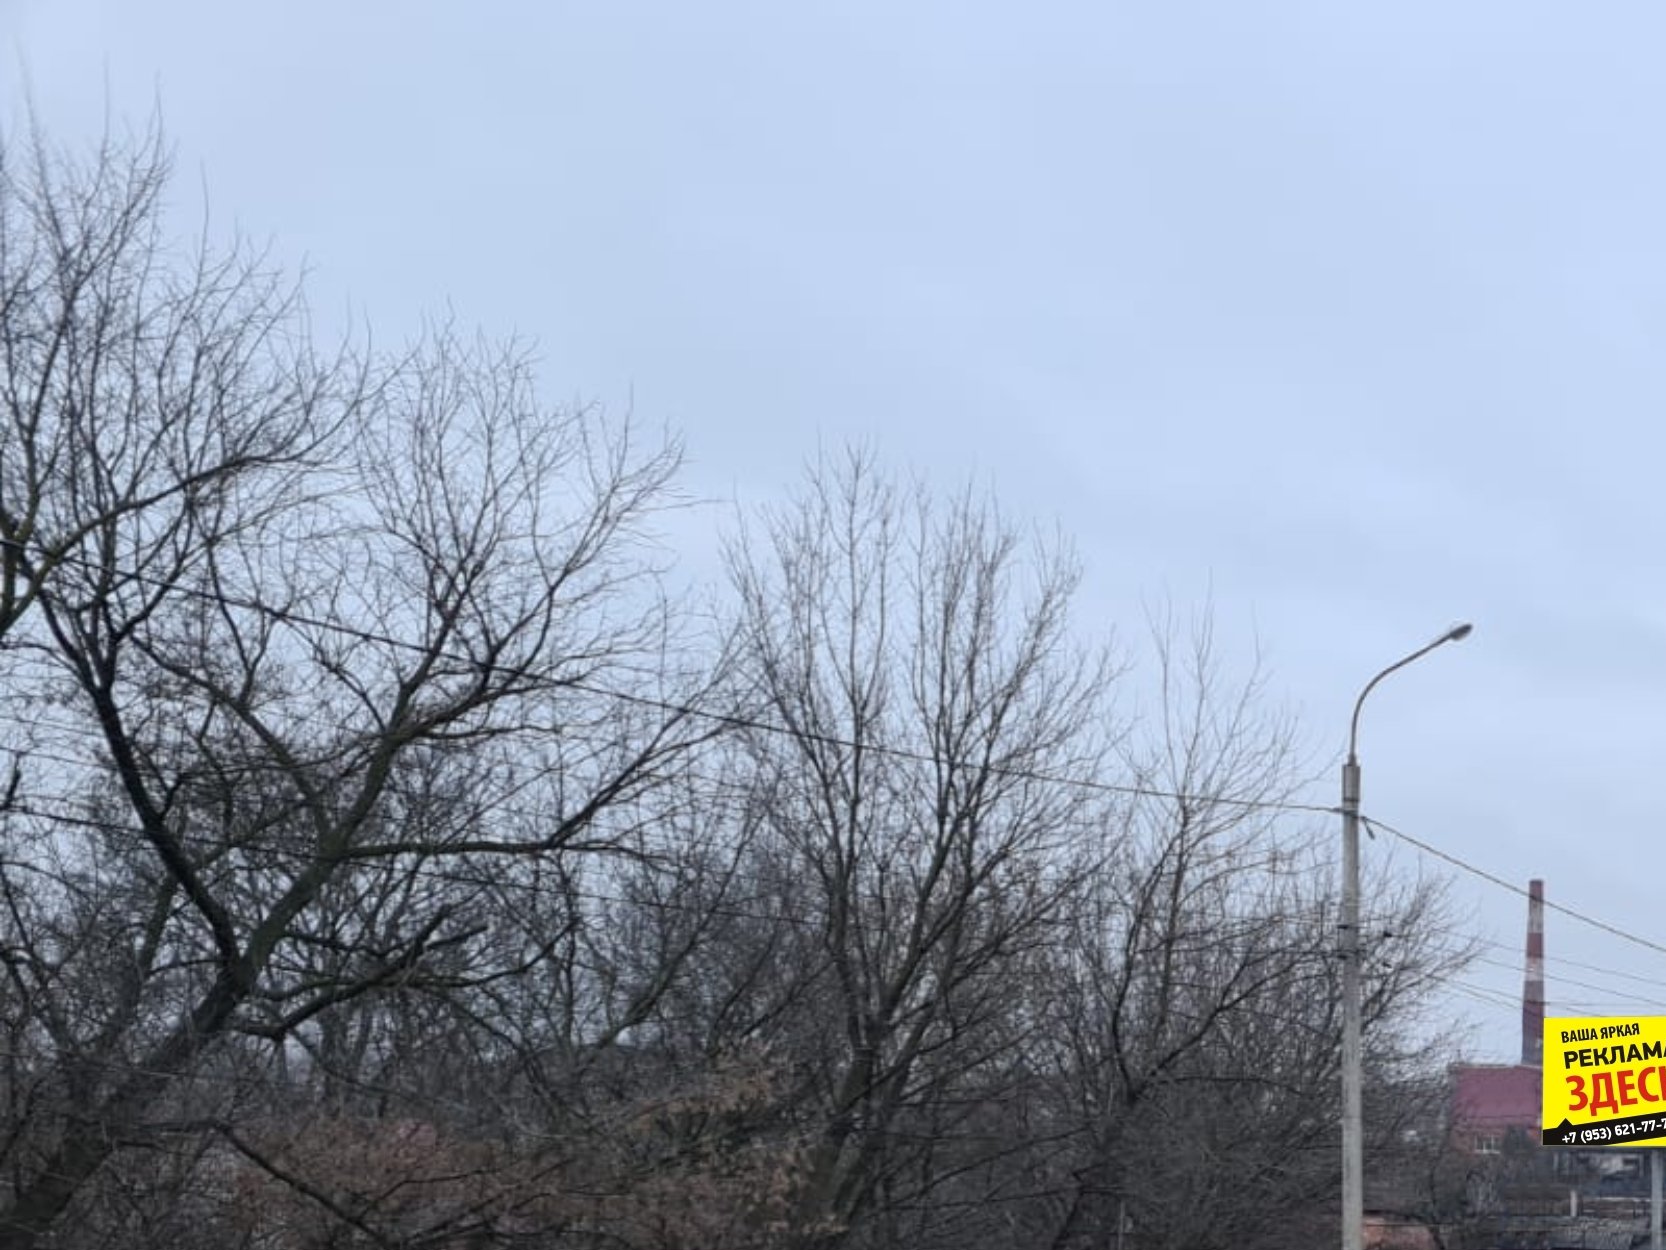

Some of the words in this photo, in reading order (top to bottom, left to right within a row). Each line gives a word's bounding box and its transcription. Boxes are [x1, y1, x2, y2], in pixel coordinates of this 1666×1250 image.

[1561, 1027, 1598, 1043] ВАША
[1600, 1023, 1640, 1039] ЯРКАЯ
[1562, 1131, 1576, 1143] +7
[1580, 1126, 1611, 1143] (953)
